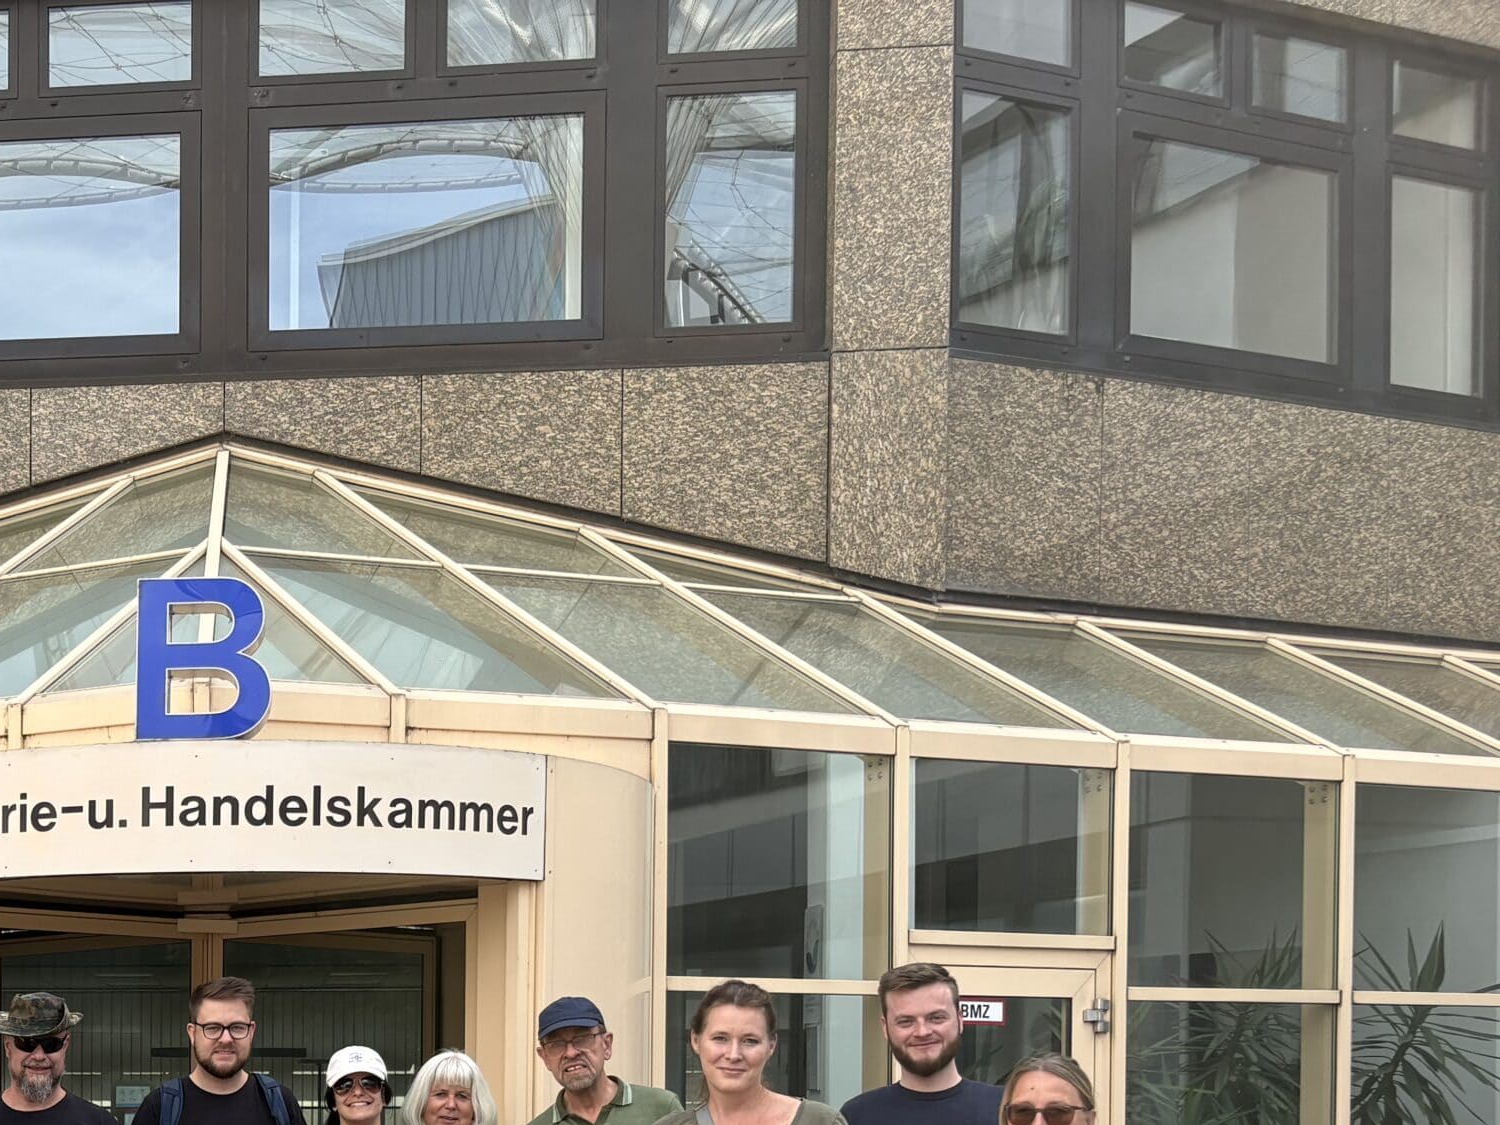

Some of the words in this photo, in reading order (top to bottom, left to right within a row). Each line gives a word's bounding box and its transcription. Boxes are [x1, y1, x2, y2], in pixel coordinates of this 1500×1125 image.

[136, 576, 272, 740] B
[140, 784, 535, 837] Handelskammer
[961, 1004, 990, 1018] BMZ
